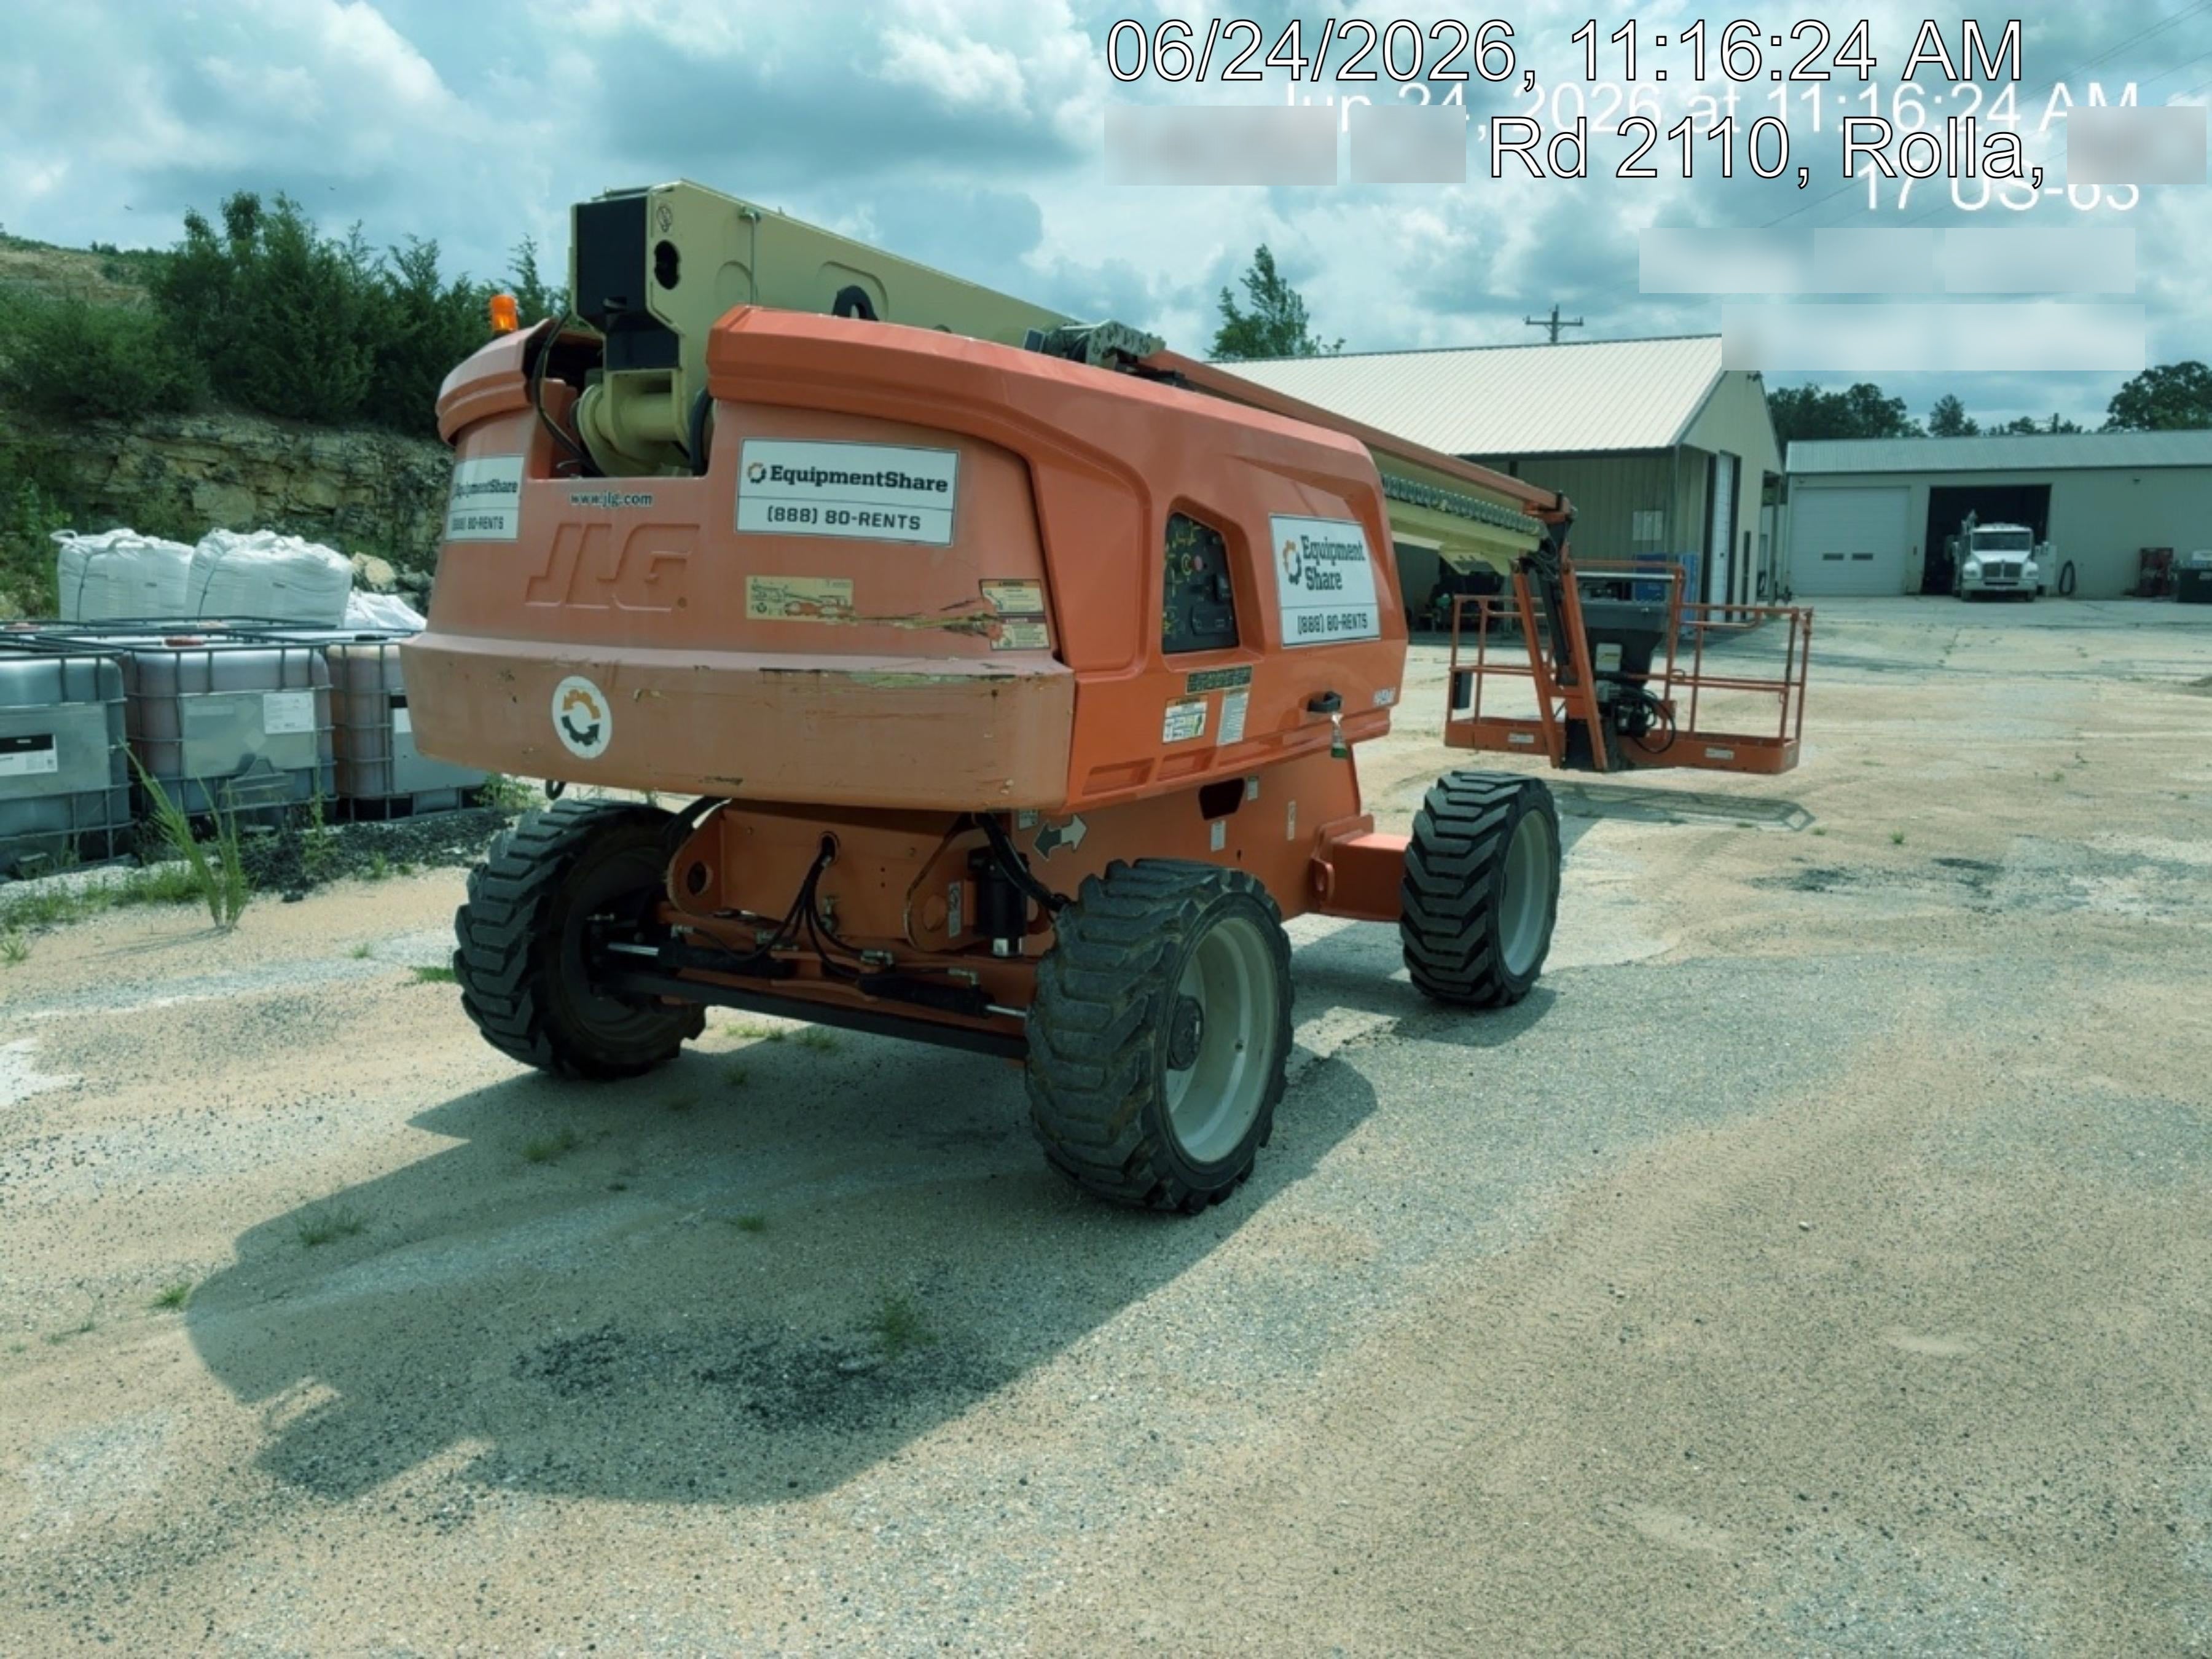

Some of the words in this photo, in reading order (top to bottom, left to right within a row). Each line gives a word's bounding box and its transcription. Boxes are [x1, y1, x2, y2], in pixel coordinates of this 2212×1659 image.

[769, 465, 948, 493] EquipmentShare
[767, 505, 818, 525] (888)
[825, 509, 921, 531] 80-RENTS
[1300, 534, 1366, 566] Equipment
[525, 522, 700, 611] JLG
[1305, 566, 1343, 590] Share
